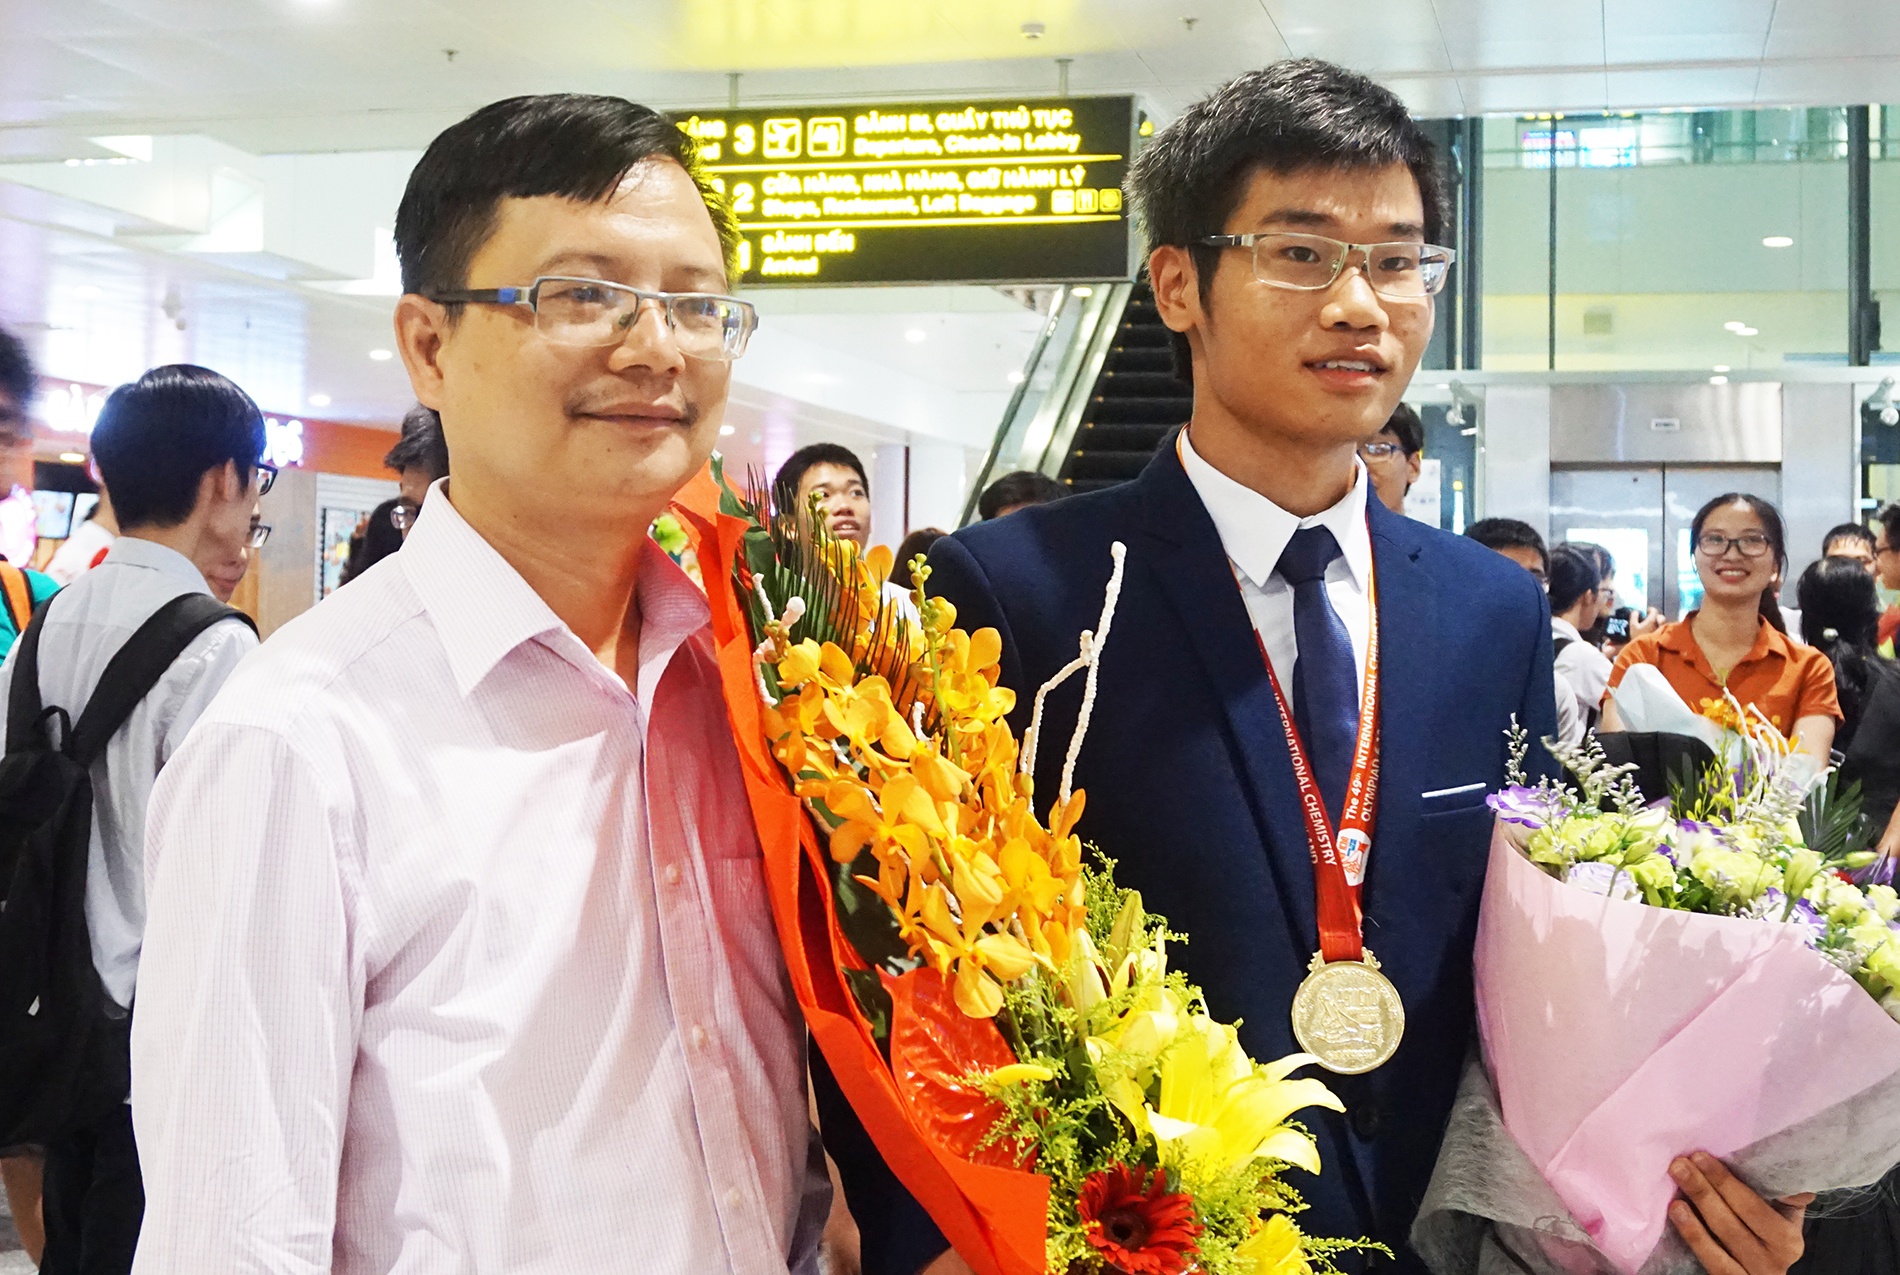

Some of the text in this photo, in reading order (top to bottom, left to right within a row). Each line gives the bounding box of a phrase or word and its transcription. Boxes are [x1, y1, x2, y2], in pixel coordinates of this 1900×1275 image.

[1032, 108, 1073, 130] TỤC
[733, 124, 756, 155] 3
[944, 133, 1022, 154] Check-in
[1024, 132, 1081, 153] Lobby
[732, 182, 755, 213] 2
[921, 195, 957, 213] Left
[957, 194, 1037, 214] Baggage
[737, 240, 751, 271] 1
[761, 256, 819, 276] Arrival
[1345, 797, 1360, 820] The
[1355, 673, 1378, 769] INTERNATIONAL
[1304, 793, 1338, 867] CHEMISTRY
